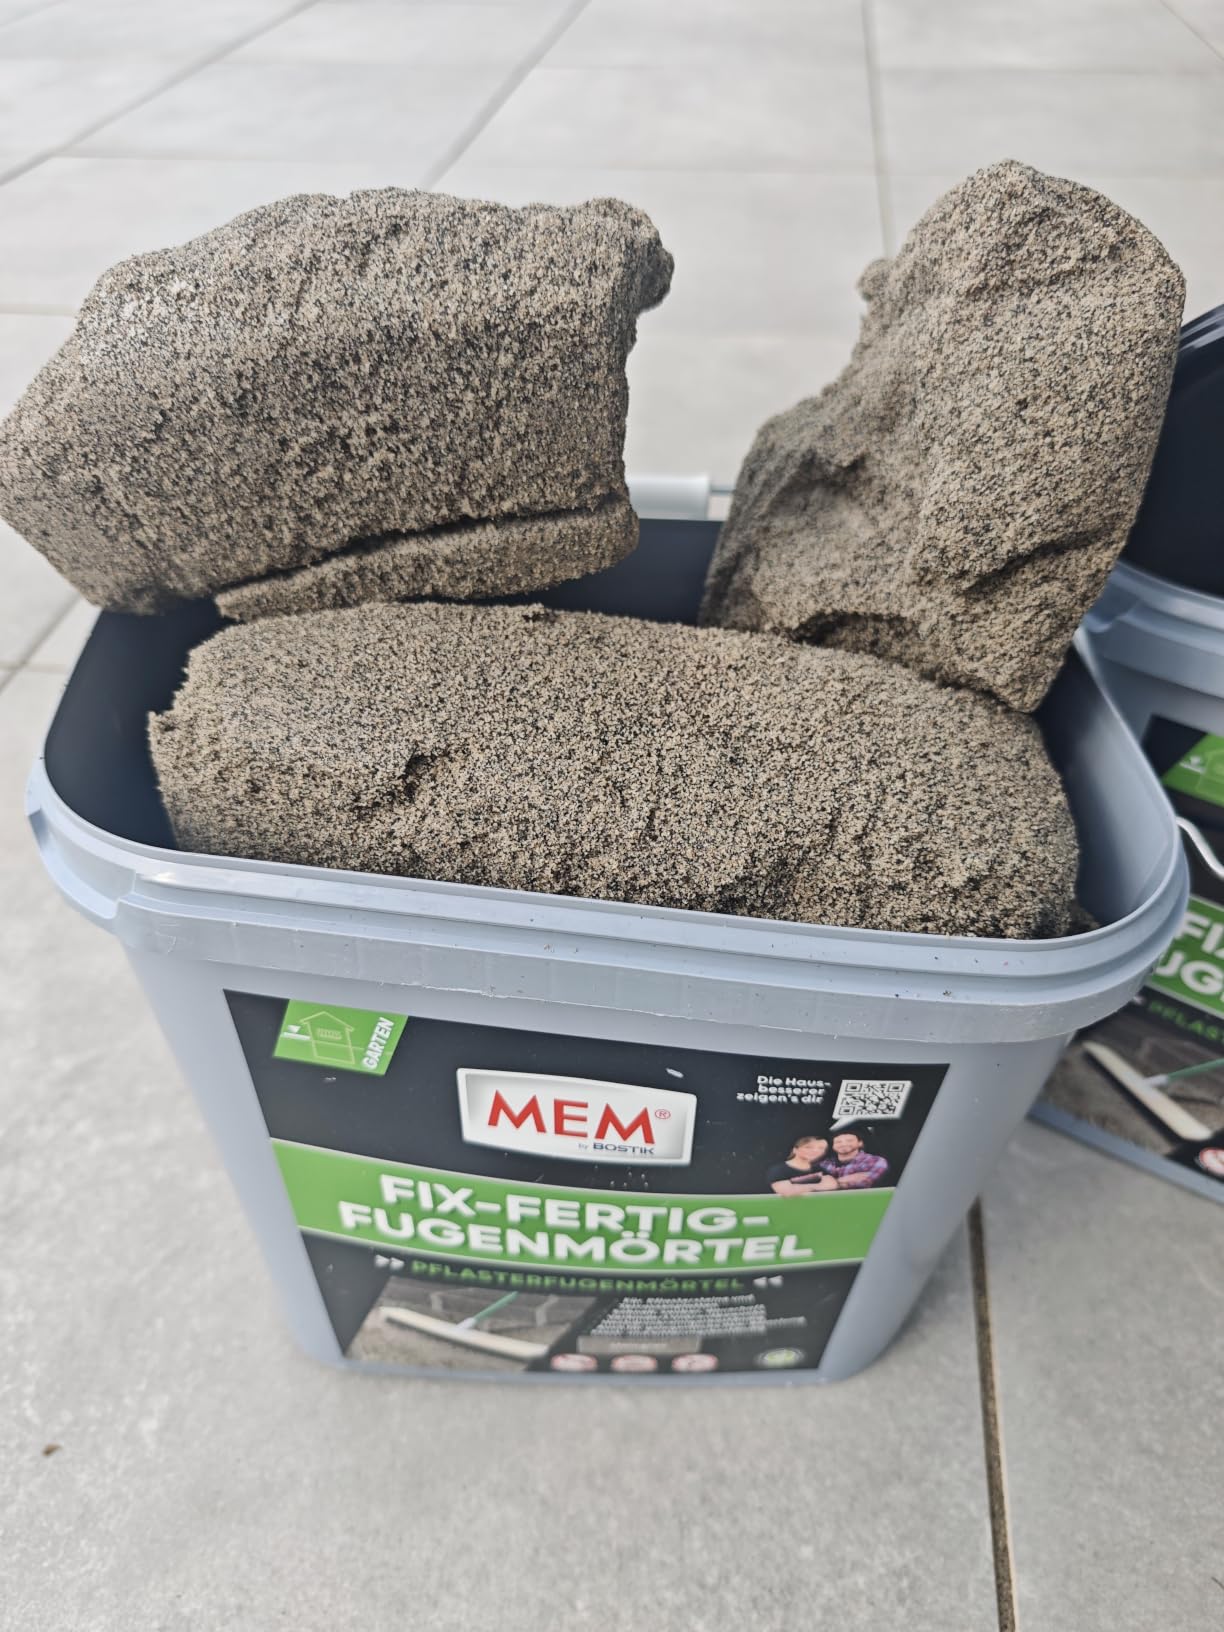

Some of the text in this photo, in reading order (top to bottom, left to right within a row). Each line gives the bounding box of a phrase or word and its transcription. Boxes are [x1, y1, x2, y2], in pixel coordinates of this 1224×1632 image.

[361, 1016, 395, 1070] GARTEN
[757, 1076, 783, 1085] Die
[801, 1095, 824, 1104] dir
[380, 1174, 769, 1235] FIX-FERTIG-
[338, 1200, 814, 1264] FUGENMÖRTEL
[411, 1260, 745, 1294] PFLASTERFUGENMÖRTEL
